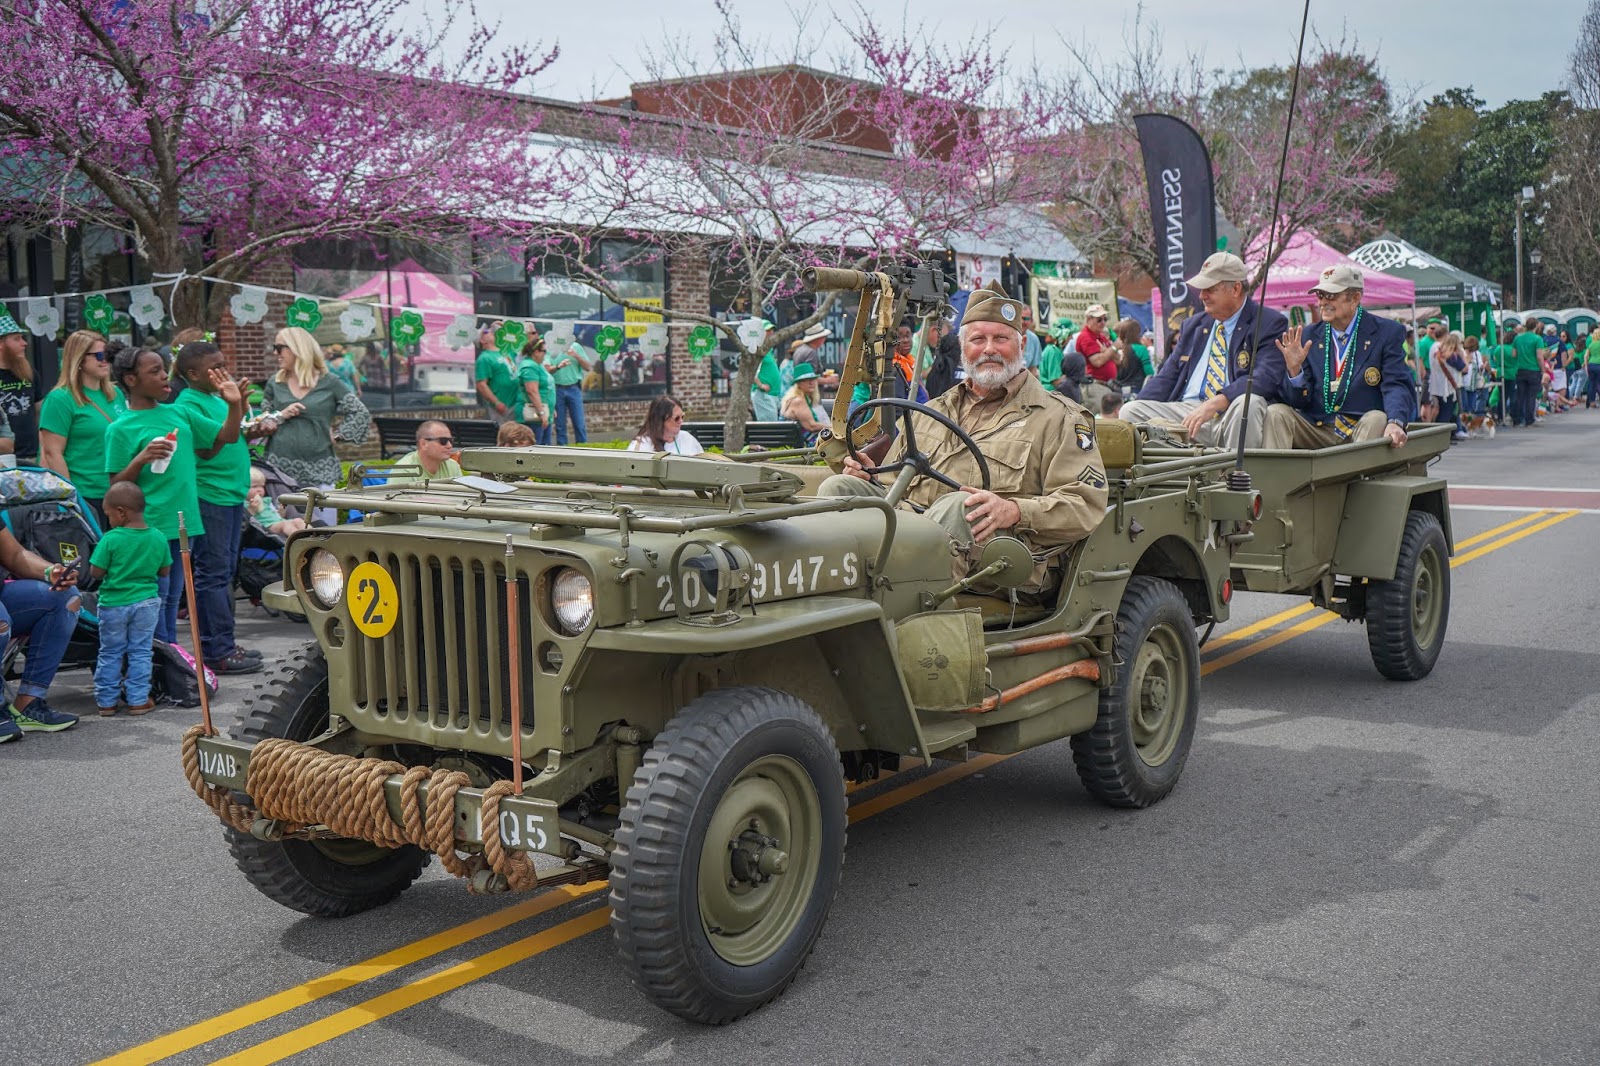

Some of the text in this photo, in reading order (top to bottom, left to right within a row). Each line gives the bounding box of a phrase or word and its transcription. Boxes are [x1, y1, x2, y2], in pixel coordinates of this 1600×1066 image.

[1053, 299, 1087, 311] GUINNESS
[1058, 290, 1099, 301] CELEBRATE
[656, 552, 858, 613] 209147-S
[358, 578, 384, 625] 2
